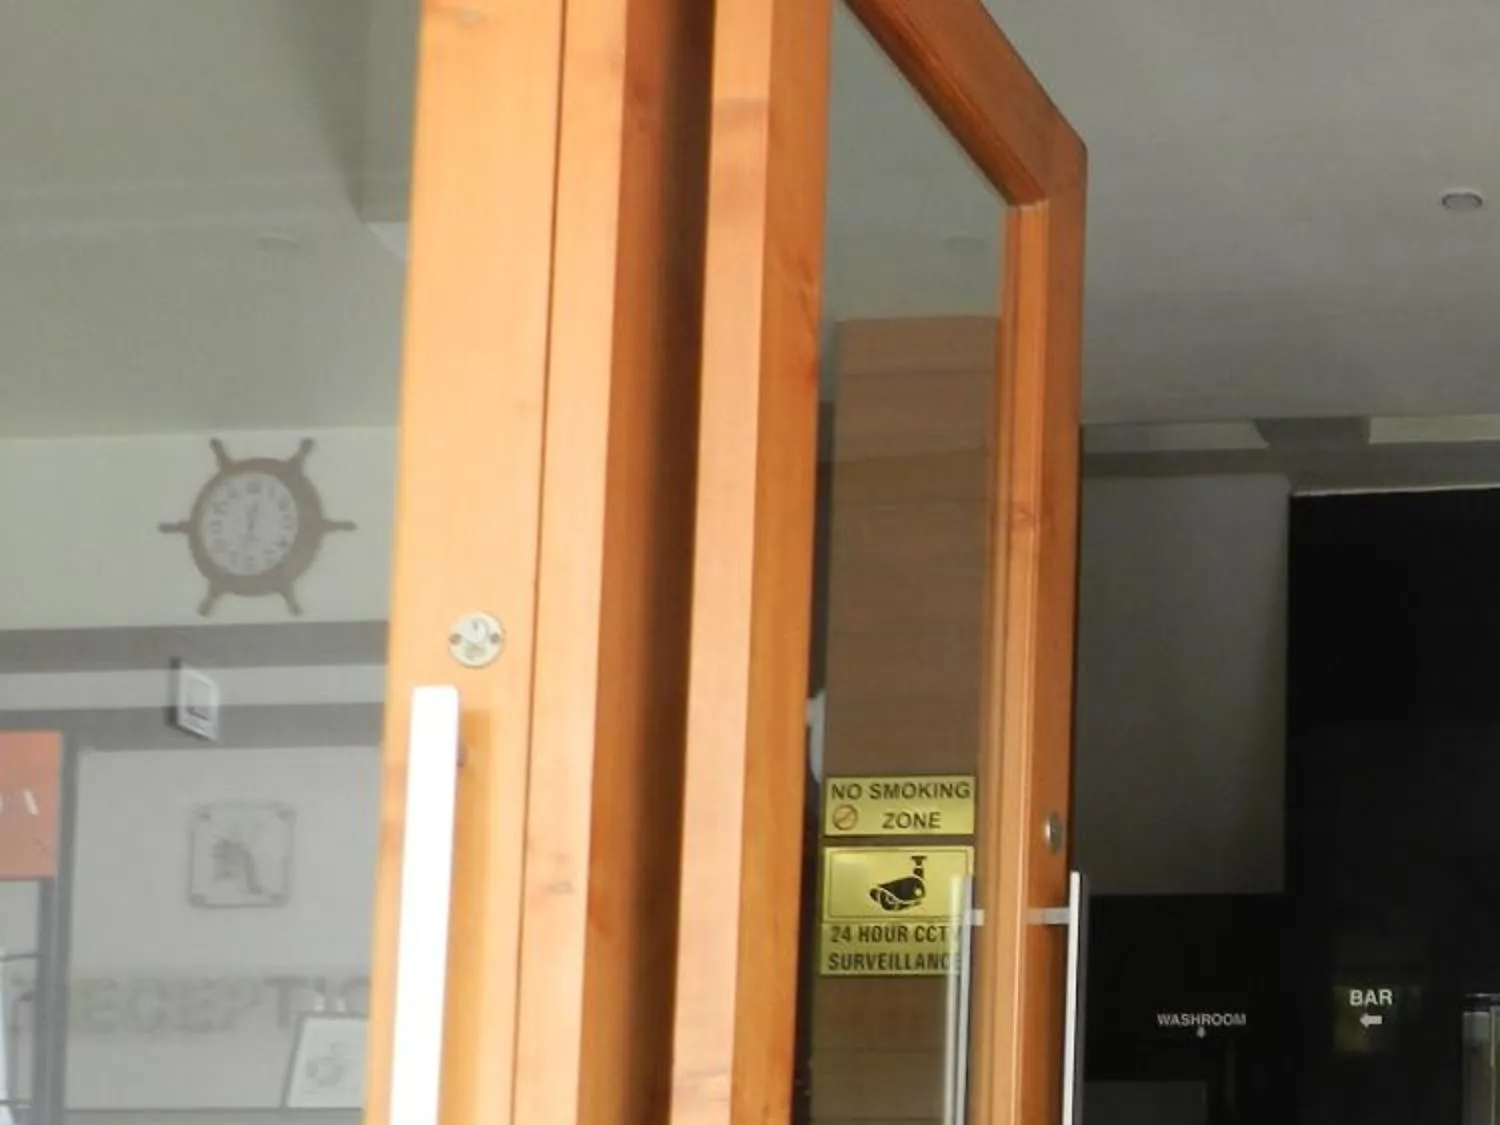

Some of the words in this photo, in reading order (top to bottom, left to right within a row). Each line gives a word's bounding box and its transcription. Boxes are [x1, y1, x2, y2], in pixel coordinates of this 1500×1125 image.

[831, 783, 862, 800] NO
[869, 781, 970, 799] SMOKING
[882, 812, 941, 829] ZONE
[831, 927, 851, 943] 24
[858, 926, 908, 943] HOUR
[914, 925, 962, 942] CCT
[1350, 989, 1393, 1006] BAR
[1157, 1013, 1247, 1026] WASHROOM
